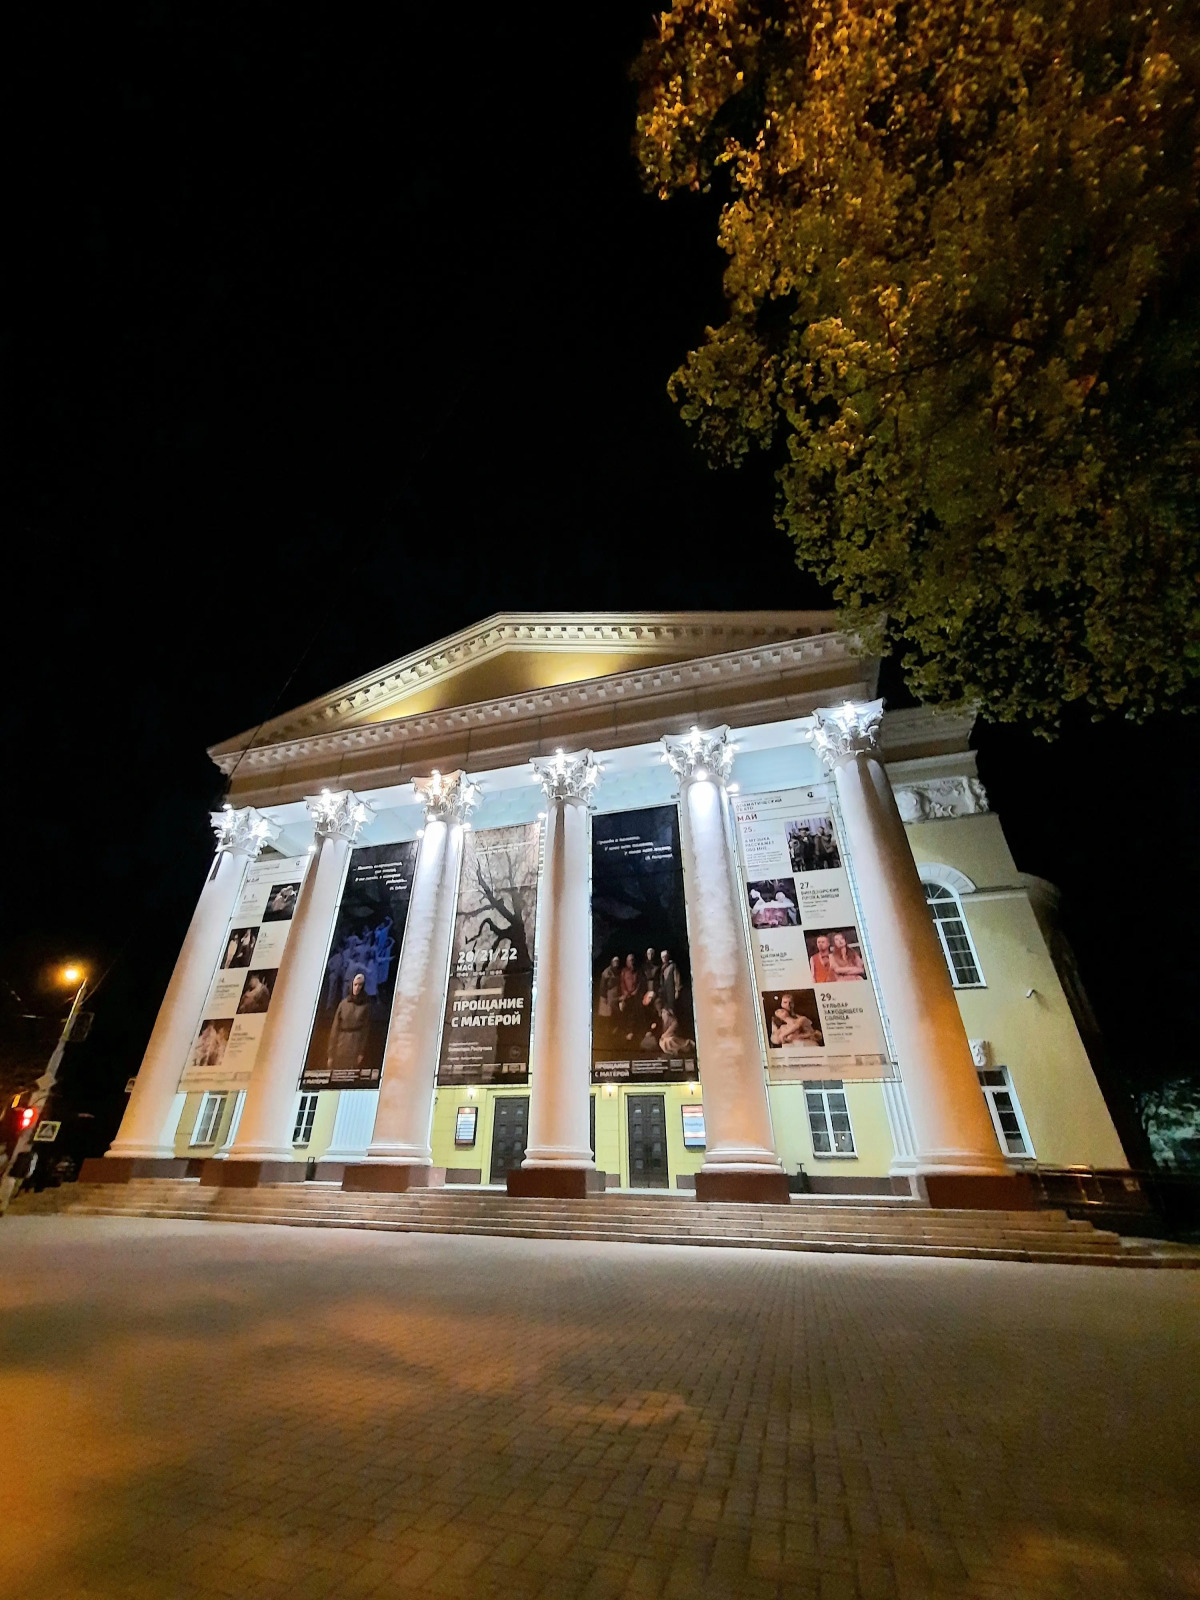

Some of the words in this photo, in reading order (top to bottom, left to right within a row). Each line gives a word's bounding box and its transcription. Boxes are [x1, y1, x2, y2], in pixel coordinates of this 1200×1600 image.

[453, 997, 524, 1012] ПРОЩАНИЕ
[820, 993, 832, 1001] 29
[451, 1016, 459, 1028] С
[461, 1011, 521, 1027] МАТЁРОЙ
